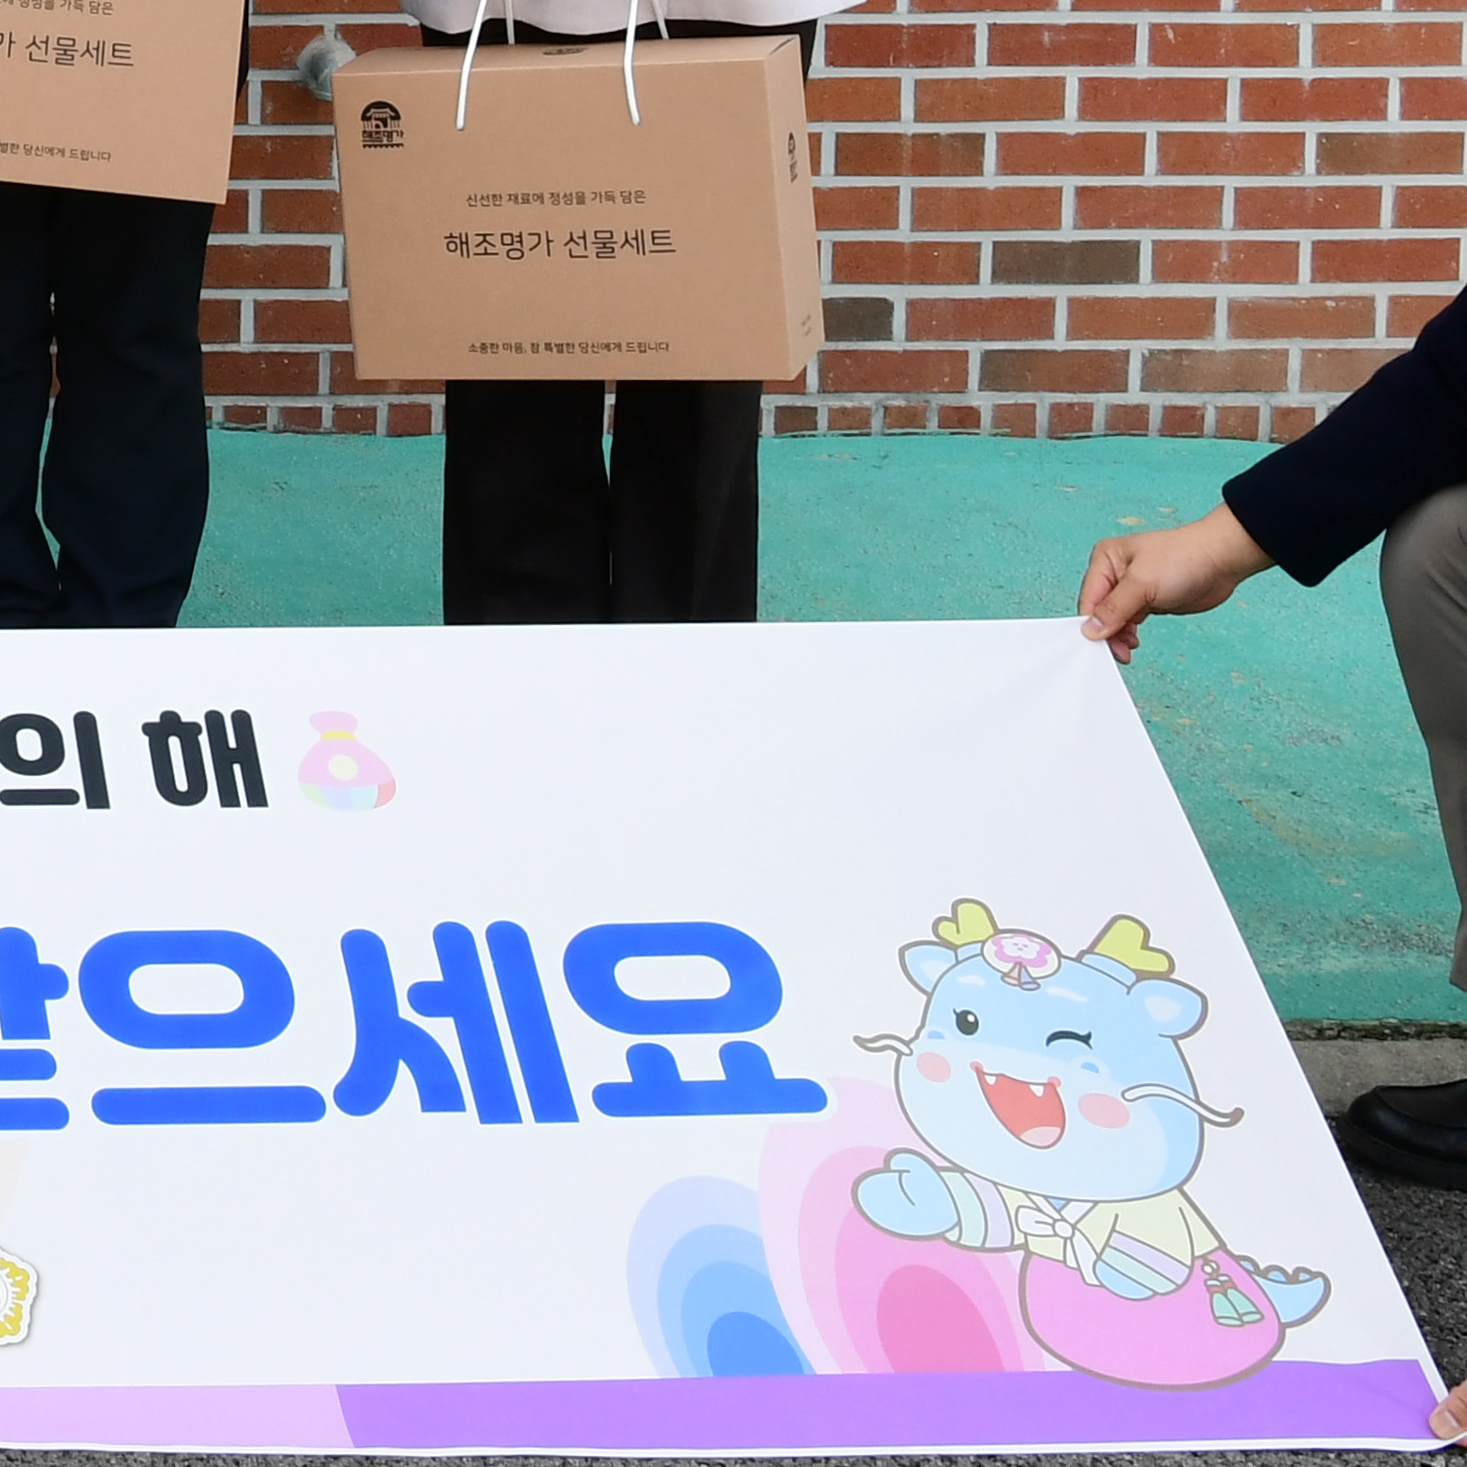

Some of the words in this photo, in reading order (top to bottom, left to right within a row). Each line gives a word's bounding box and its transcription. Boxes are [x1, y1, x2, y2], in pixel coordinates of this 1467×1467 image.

[88, 0, 114, 16] 담은
[25, 34, 134, 67] 선물세트
[22, 143, 66, 158] 당신에게
[68, 148, 112, 163] 드립니다
[465, 193, 503, 208] 신선한
[506, 192, 545, 206] 재료에
[548, 190, 586, 207] 정성을
[590, 190, 616, 205] 가득
[619, 189, 647, 205] 담은
[443, 230, 554, 261] 해조명가
[563, 228, 677, 259] 선물세트
[468, 342, 500, 355] 소중한
[543, 341, 576, 355] 특별한
[577, 341, 623, 355] 당신에게
[625, 341, 670, 354] 드립니다
[141, 709, 268, 808] 해
